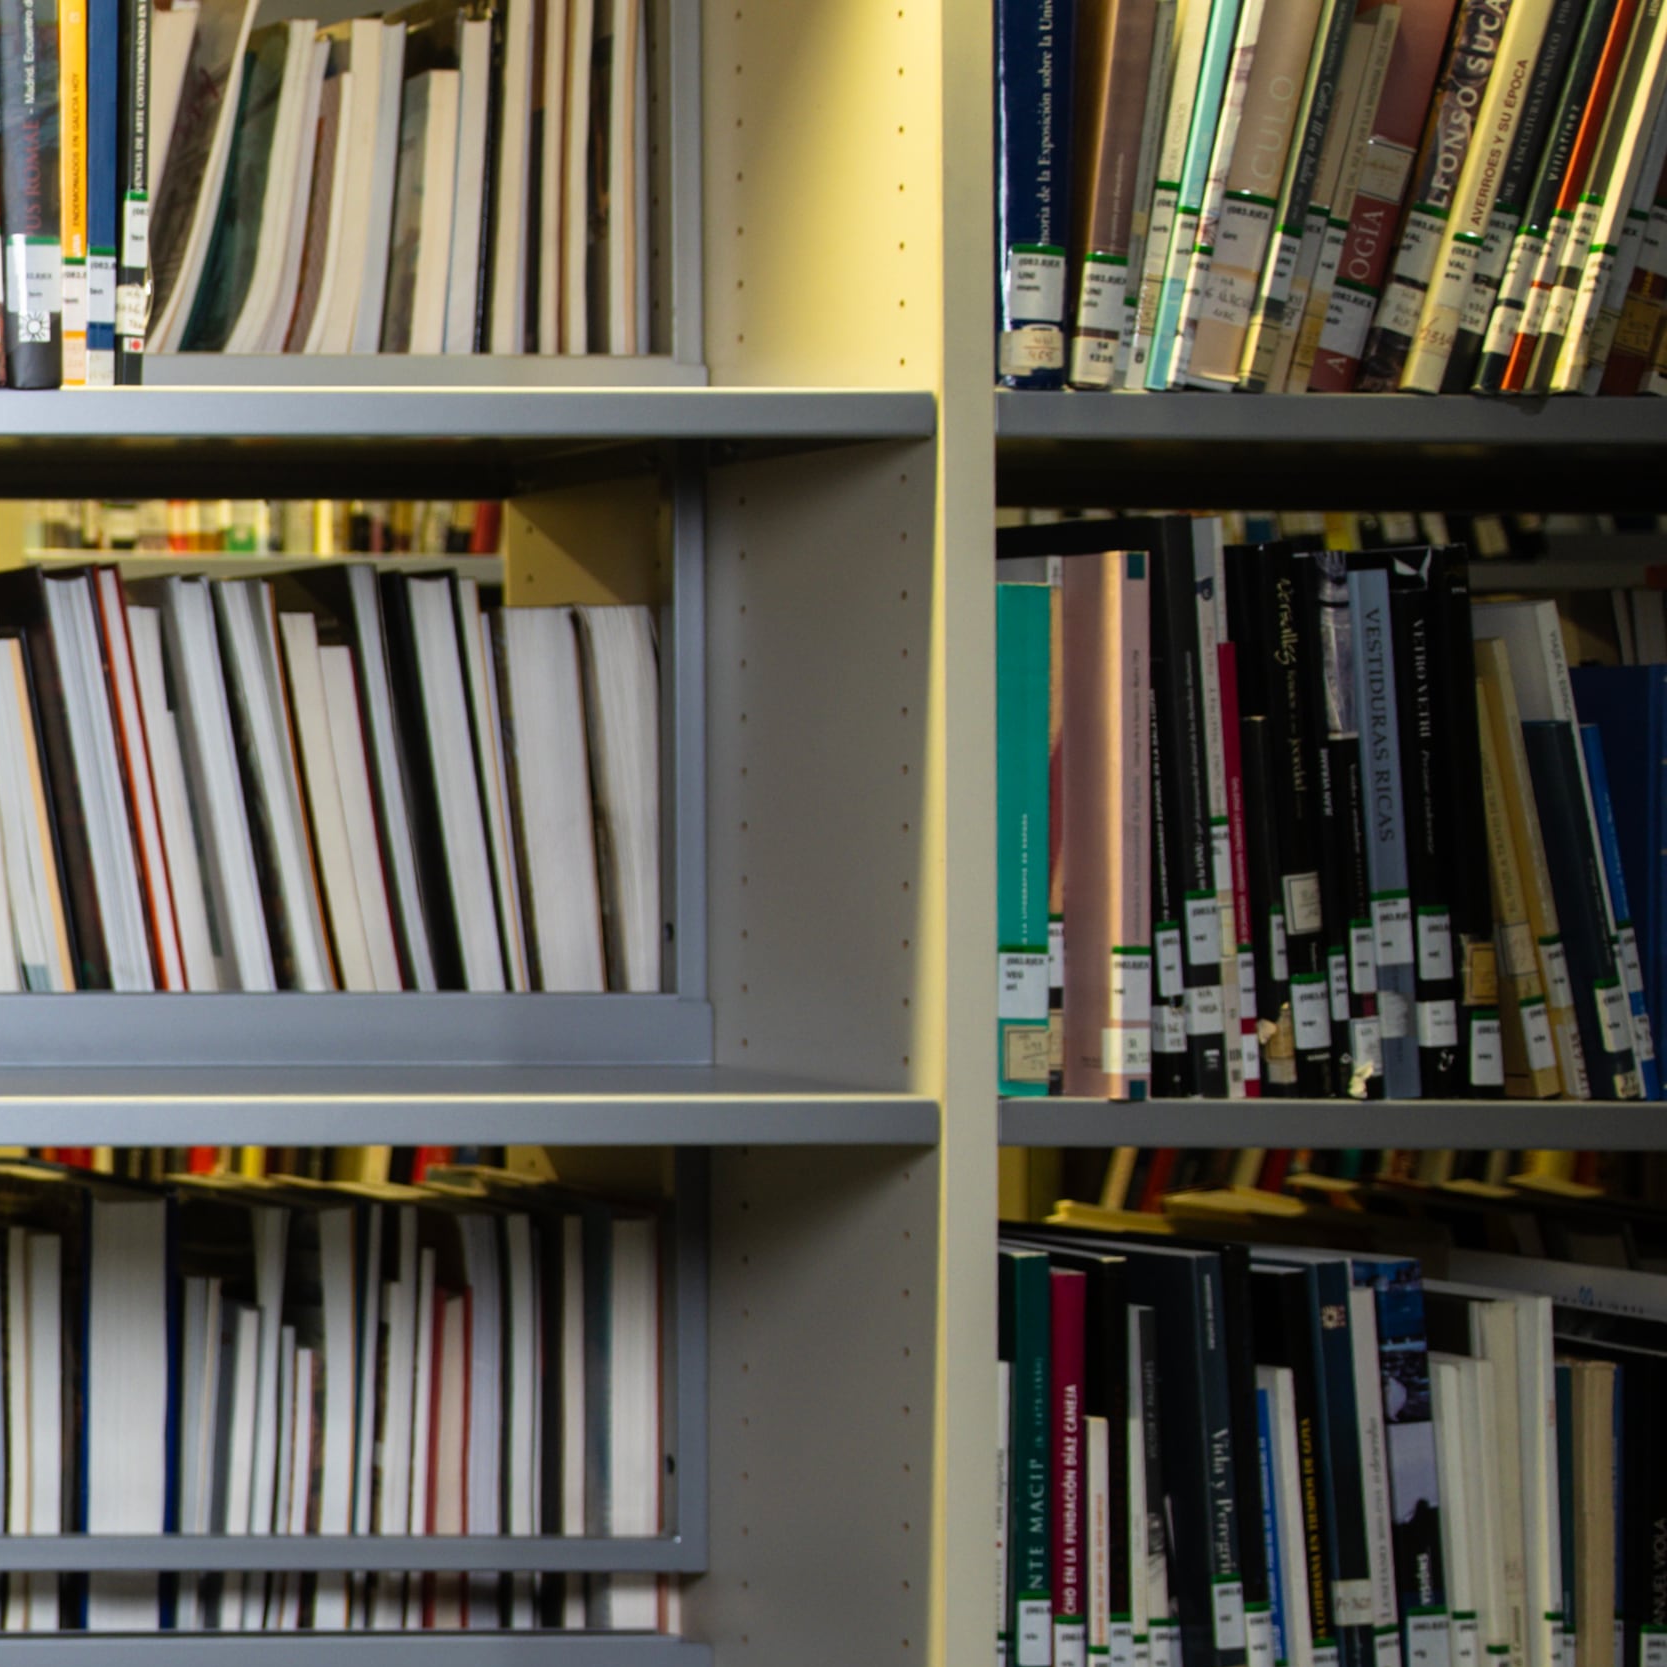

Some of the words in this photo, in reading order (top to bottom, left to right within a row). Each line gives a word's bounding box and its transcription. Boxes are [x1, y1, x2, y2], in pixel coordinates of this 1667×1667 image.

[1039, 34, 1052, 45] la
[1039, 50, 1052, 87] sobre
[1501, 57, 1528, 109] ÉPOCA
[1497, 111, 1512, 132] SU
[1493, 136, 1504, 145] Y
[1038, 169, 1051, 181] la
[1470, 147, 1501, 225] AVERROES
[1038, 185, 1050, 201] de
[1362, 606, 1390, 760] VESTIDURAS
[1374, 769, 1396, 842] RICAS
[1063, 1435, 1076, 1465] DÍAZ
[1062, 1469, 1076, 1543] FUNDACIÓN
[1063, 1547, 1075, 1561] LA
[1064, 1566, 1076, 1582] EN
